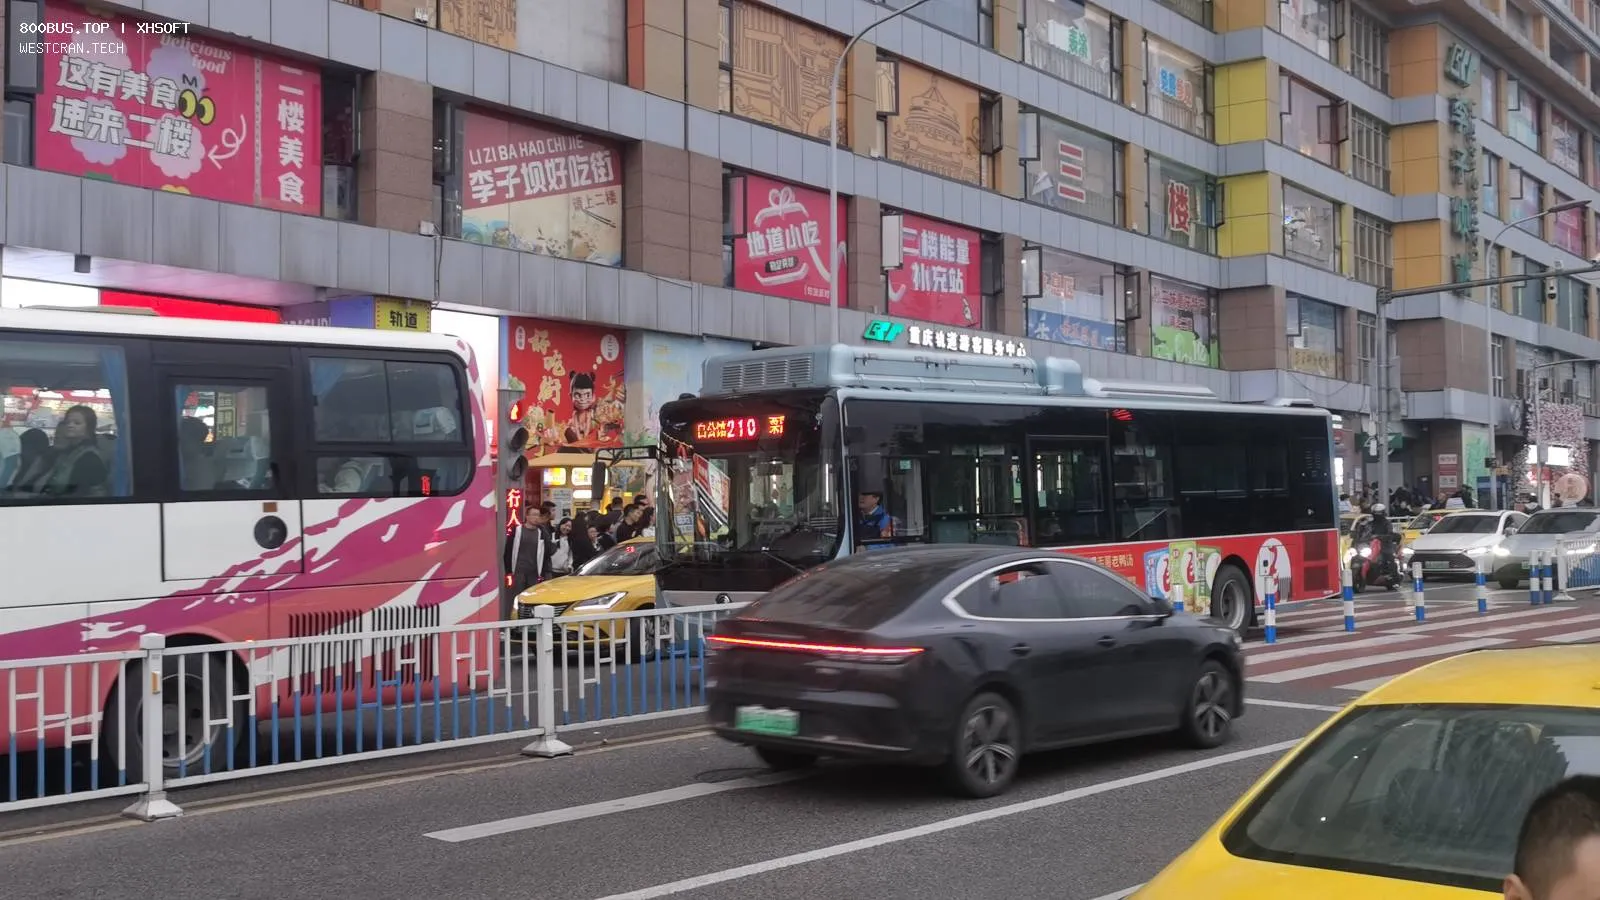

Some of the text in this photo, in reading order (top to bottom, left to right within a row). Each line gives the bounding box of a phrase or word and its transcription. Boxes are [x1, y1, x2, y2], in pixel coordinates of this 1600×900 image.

[56, 54, 179, 111] 这有美食
[191, 52, 226, 75] food
[49, 94, 193, 159] 速来二楼
[277, 64, 305, 206] 二楼美食
[519, 139, 546, 157] HAO
[468, 149, 616, 205] 李子坝好吃街
[746, 220, 821, 259] 地道小吃
[902, 226, 970, 266] 二楼能量
[910, 261, 965, 295] 补充站
[389, 310, 418, 329] 轨道
[908, 326, 1028, 358] 重庆轨道游客服务中心
[727, 418, 756, 438] 210
[507, 488, 521, 528] 行人
